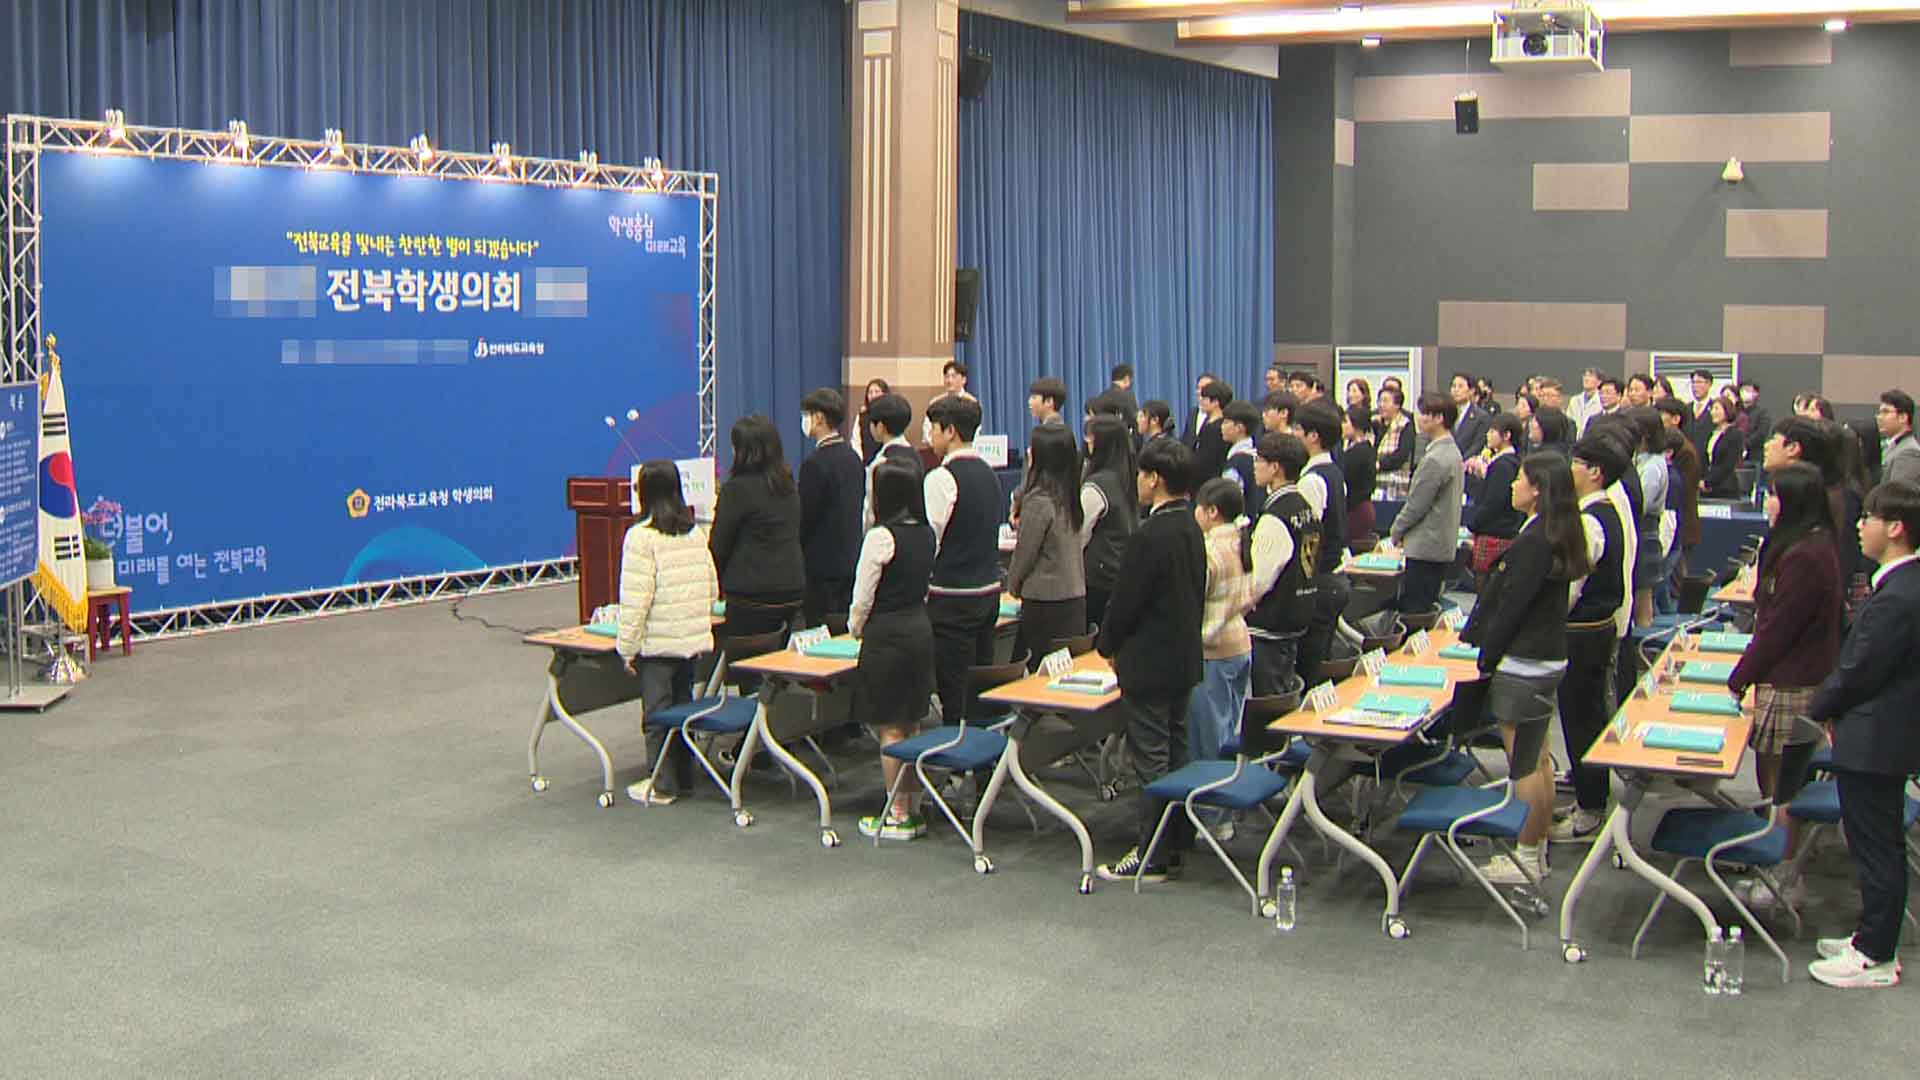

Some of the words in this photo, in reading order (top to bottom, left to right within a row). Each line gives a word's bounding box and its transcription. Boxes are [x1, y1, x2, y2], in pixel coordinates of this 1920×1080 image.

[355, 232, 395, 257] 빛내는
[446, 235, 471, 258] 별이
[645, 235, 687, 260] 미래교육
[326, 268, 521, 313] 전북학생의회
[373, 488, 449, 512] 전라북도교육청
[452, 484, 493, 505] 학생의회
[118, 555, 170, 585] 미래를
[176, 552, 207, 579] 여는
[213, 545, 267, 575] 전북교육
